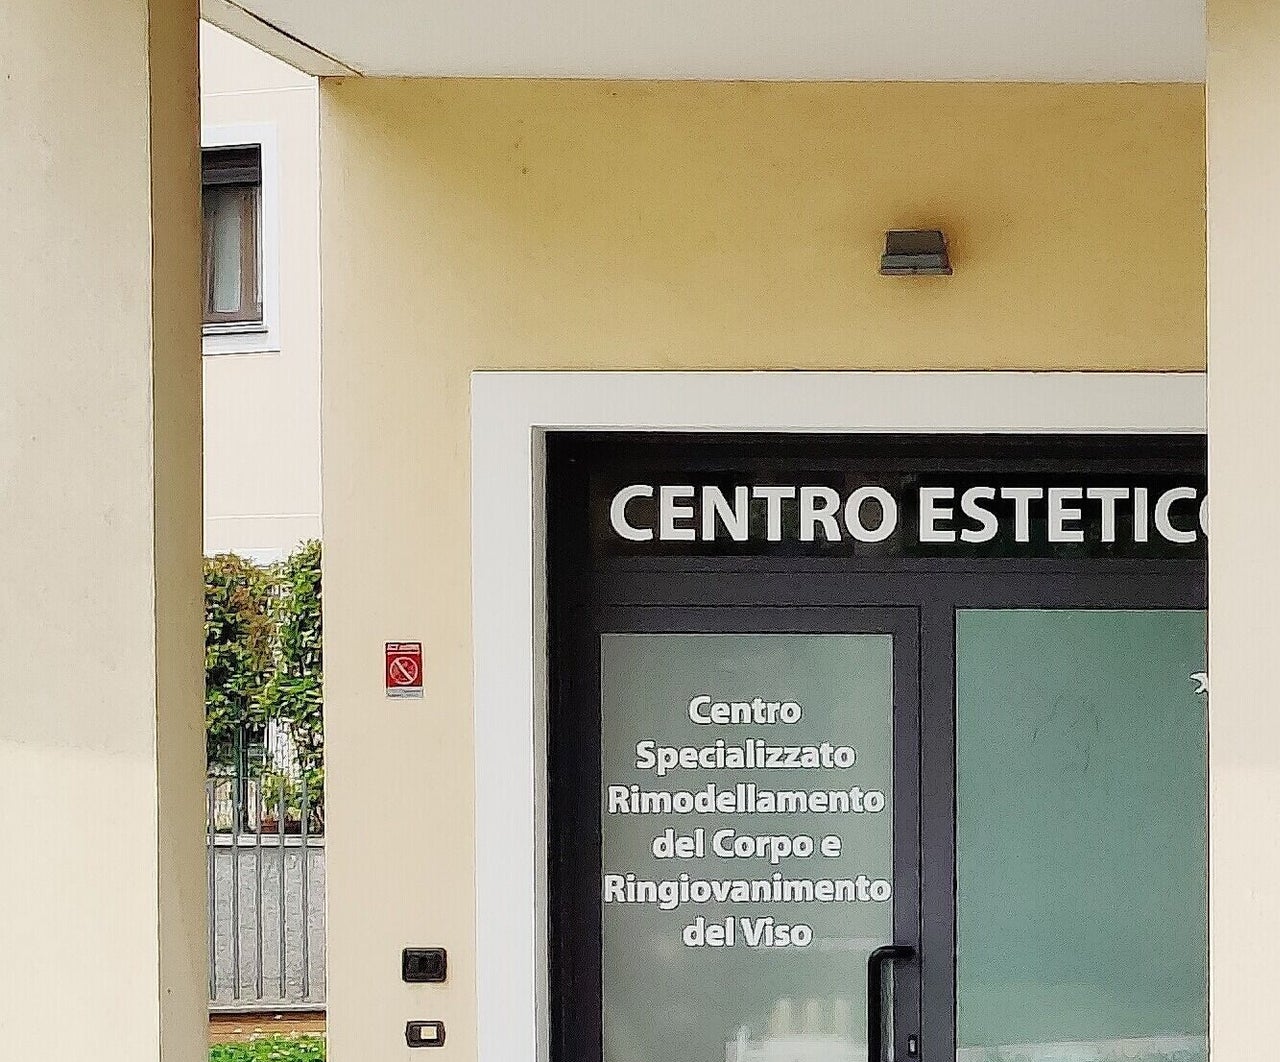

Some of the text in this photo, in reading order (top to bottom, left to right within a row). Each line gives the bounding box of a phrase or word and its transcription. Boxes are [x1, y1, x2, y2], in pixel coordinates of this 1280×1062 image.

[609, 484, 1208, 543] CENTRO ESTETIC
[689, 694, 802, 725] Centro
[635, 739, 856, 776] Specializzato
[607, 783, 886, 813] Rimodellamento
[652, 828, 842, 865] del Corpo e
[604, 873, 893, 910] Ringiovanimento
[682, 917, 813, 947] del Viso
